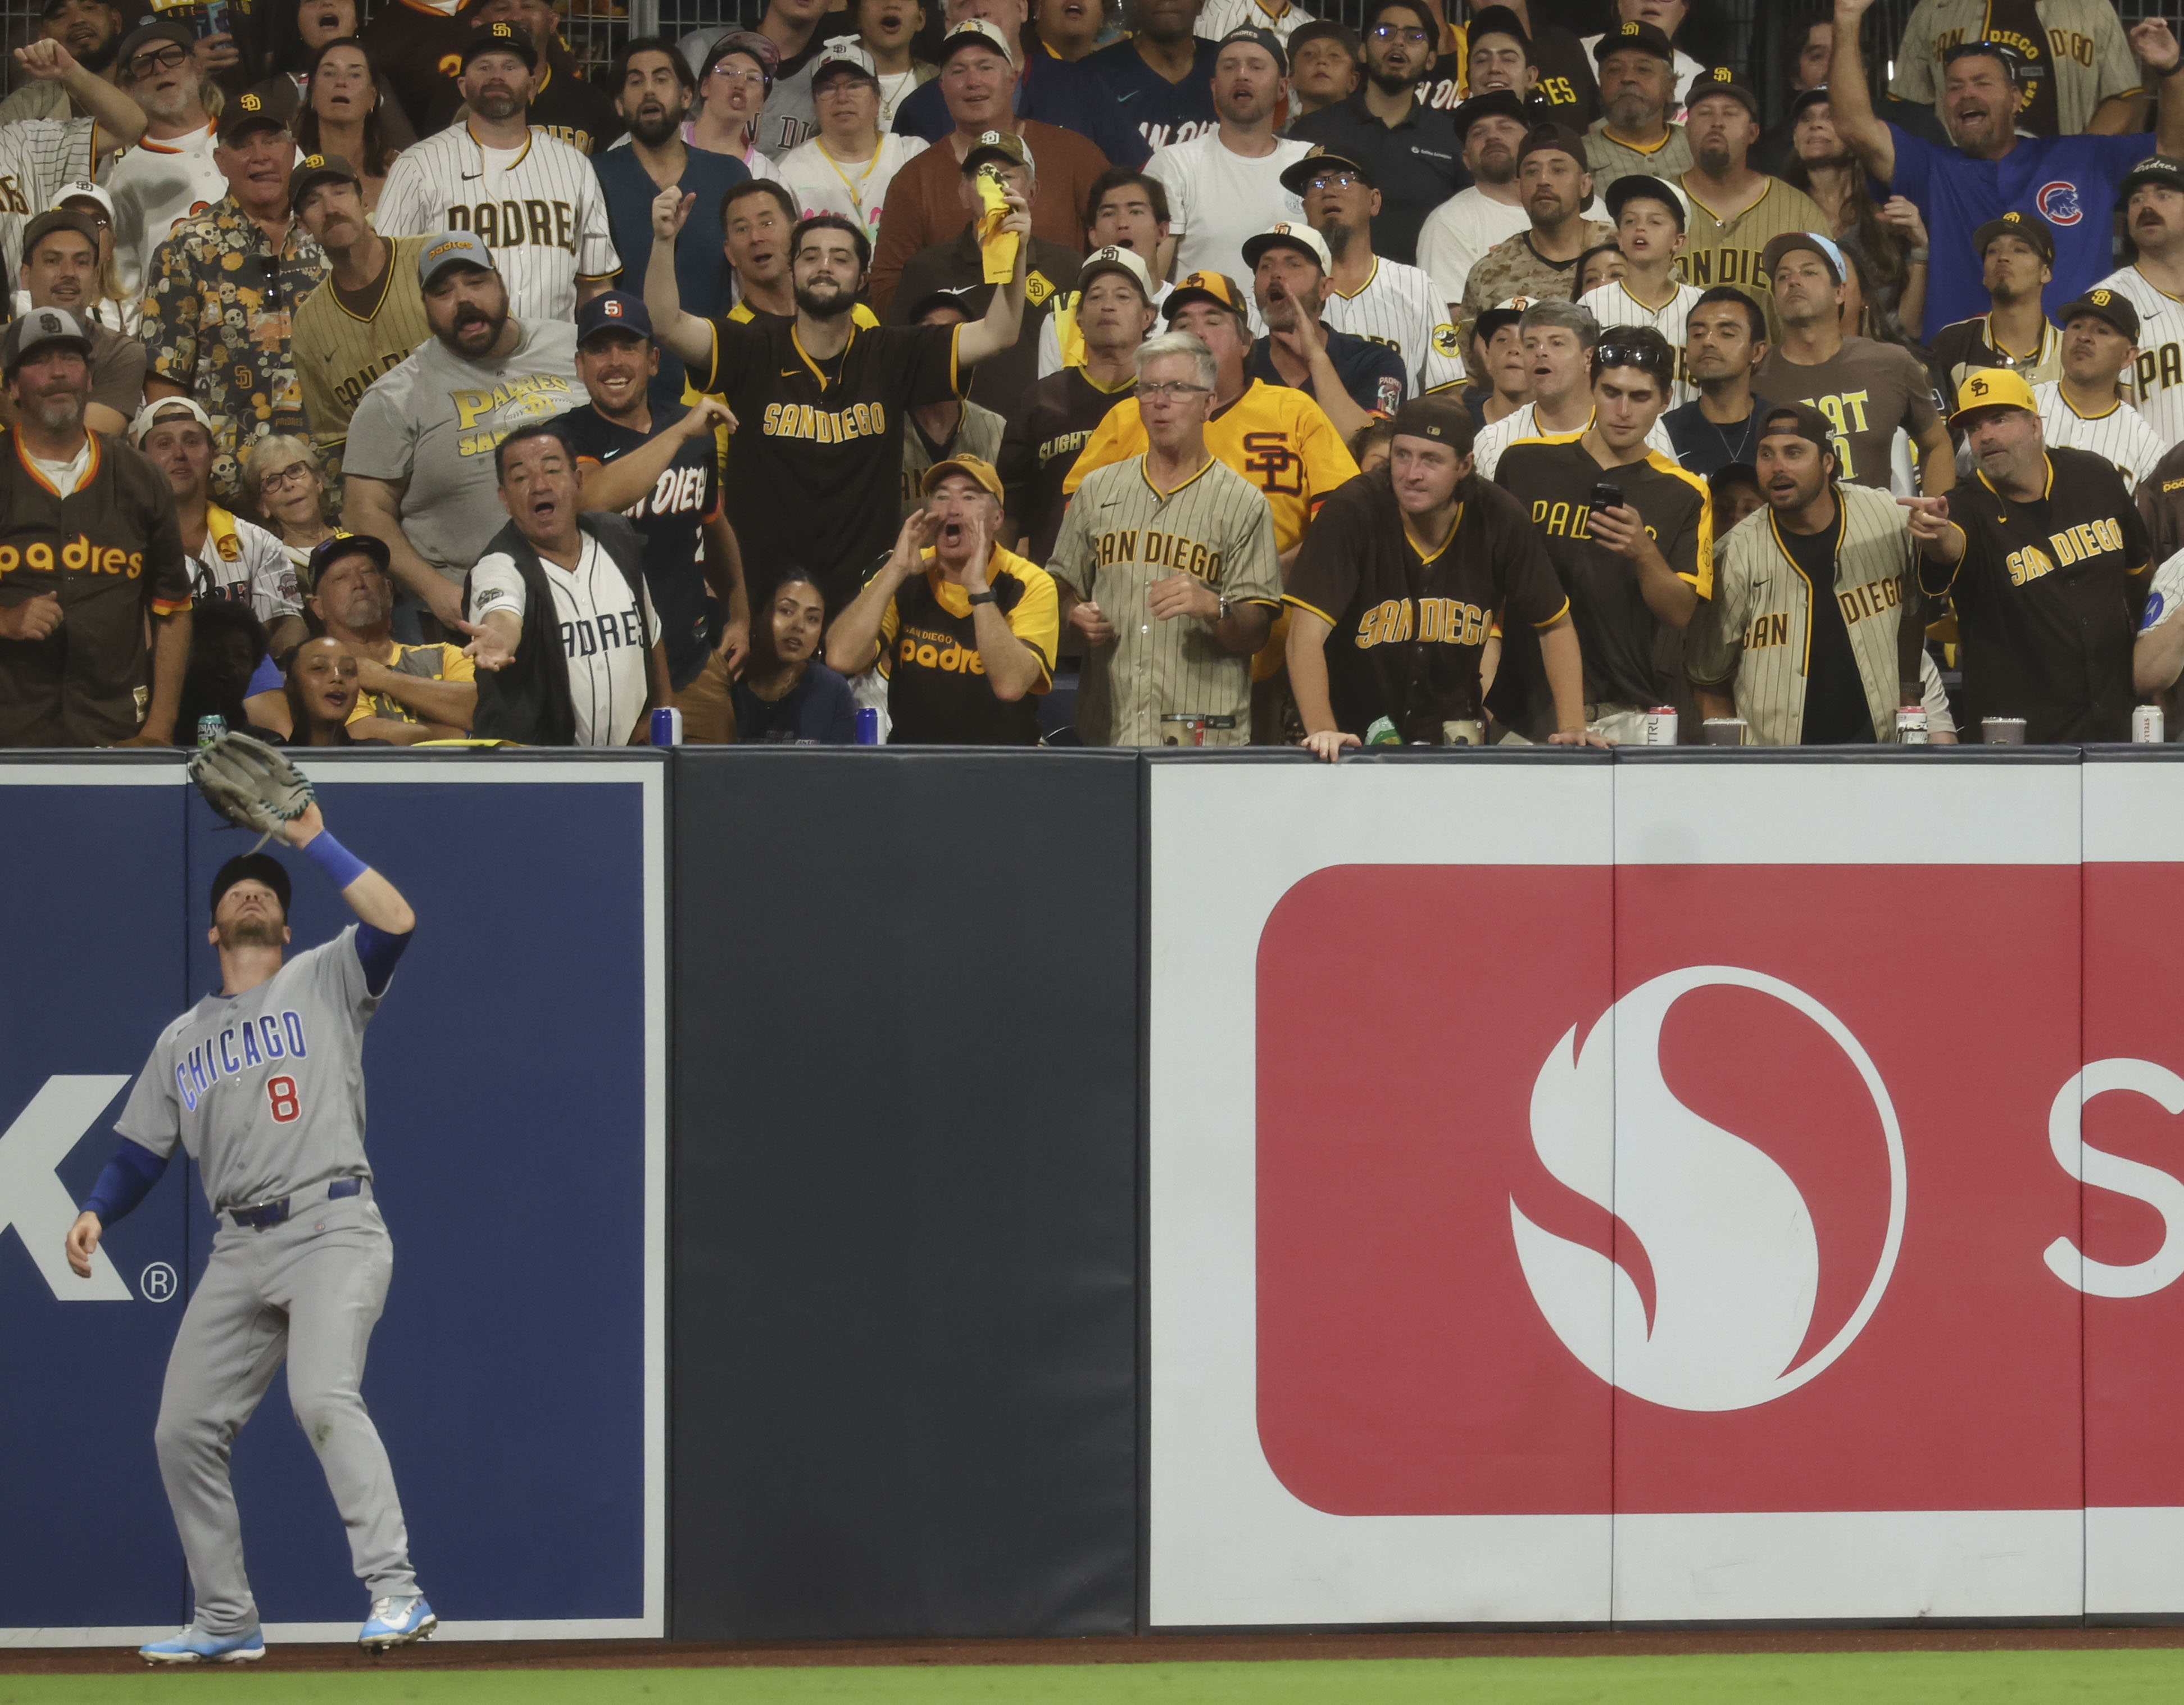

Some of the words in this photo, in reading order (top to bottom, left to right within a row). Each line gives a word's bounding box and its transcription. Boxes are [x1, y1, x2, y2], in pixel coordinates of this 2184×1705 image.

[1990, 30, 2038, 60] DIEGO
[240, 93, 261, 111] SD
[982, 130, 1000, 145] SD
[448, 199, 576, 257] PADRE
[428, 240, 473, 261] padres
[1718, 248, 1768, 289] DIE
[1029, 278, 1045, 297] SD
[2091, 289, 2112, 307] SD
[39, 313, 62, 334] SD
[604, 300, 623, 317] SD
[234, 365, 252, 389] SD
[1970, 377, 1988, 398] SD
[449, 373, 572, 431] PADRES
[1243, 431, 1305, 497] SD
[650, 465, 708, 515] DIEG
[1143, 530, 1224, 585] DIEGO
[2006, 545, 2055, 587] SAN
[2048, 517, 2124, 567] DIEGO
[1838, 574, 1904, 627] DIEGO
[922, 628, 953, 645] DIEGO
[1355, 597, 1414, 649] SAN
[174, 1010, 307, 1112] CHICAGO
[266, 1075, 302, 1124] 8
[2043, 1057, 2184, 1298] S
